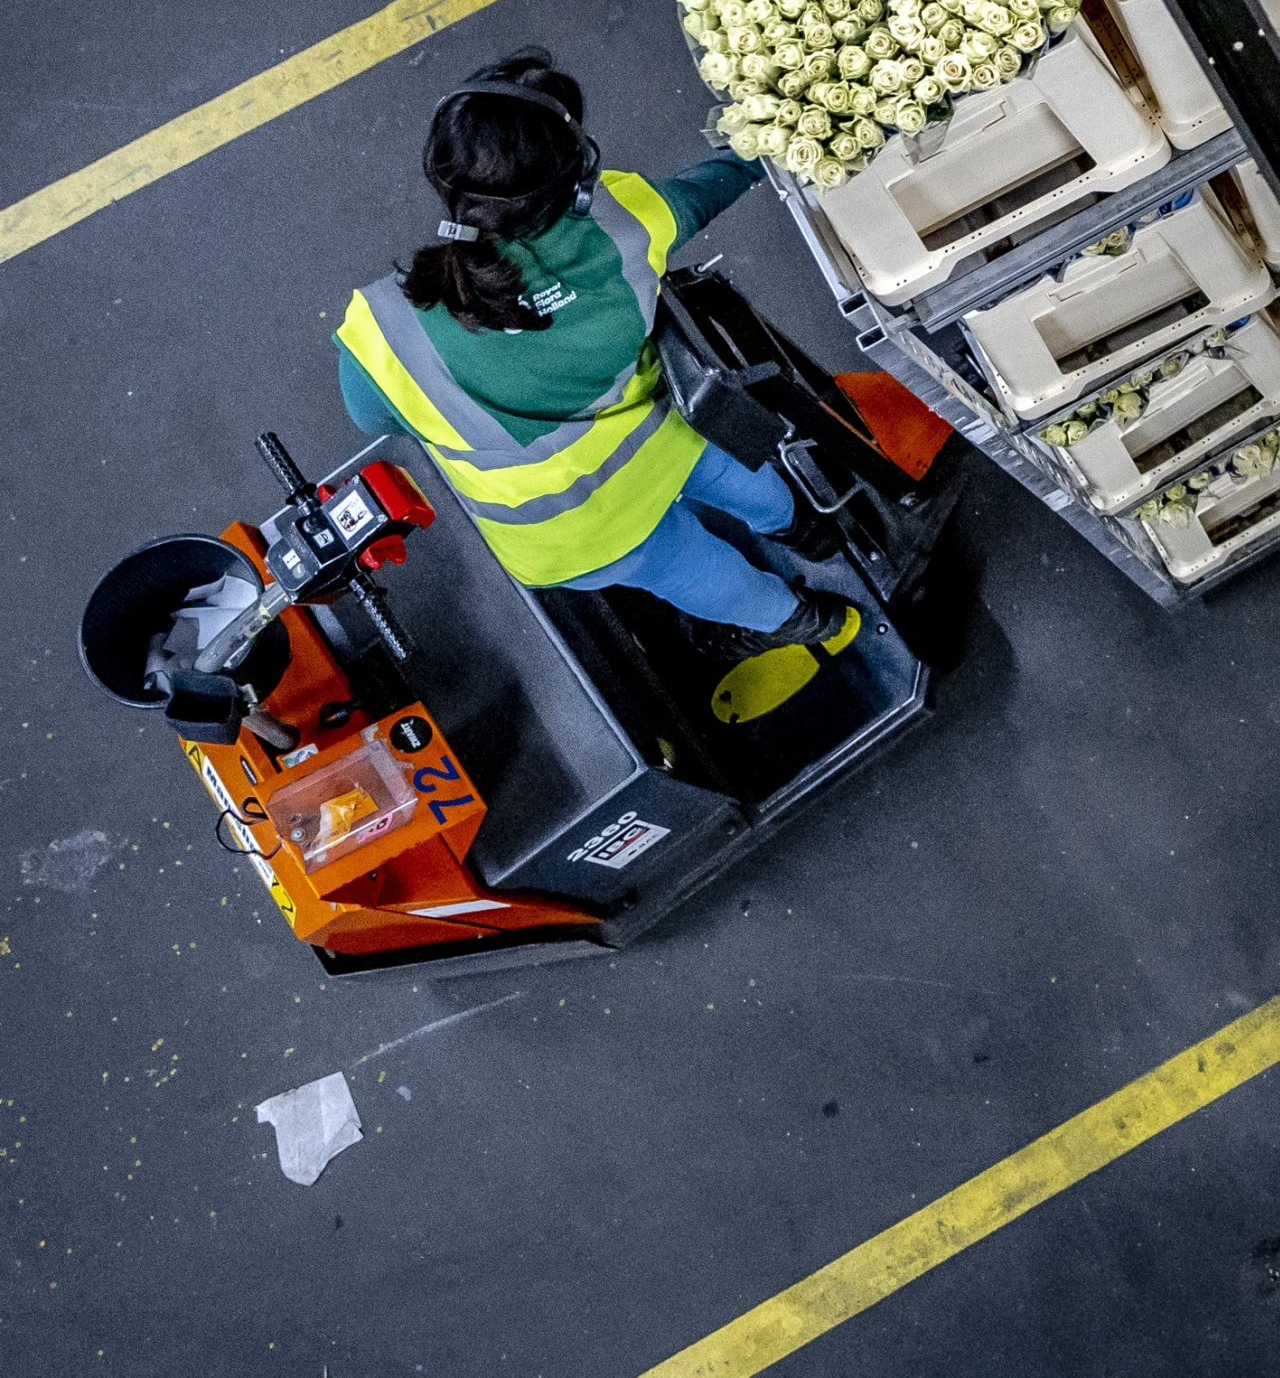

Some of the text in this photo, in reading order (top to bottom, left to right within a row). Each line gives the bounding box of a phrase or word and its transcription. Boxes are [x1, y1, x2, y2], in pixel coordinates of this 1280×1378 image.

[533, 282, 561, 302] Royal
[535, 291, 562, 309] Flora
[538, 290, 577, 316] Holland
[400, 723, 422, 749] ZWART
[413, 755, 476, 826] 72
[566, 811, 638, 862] 2360
